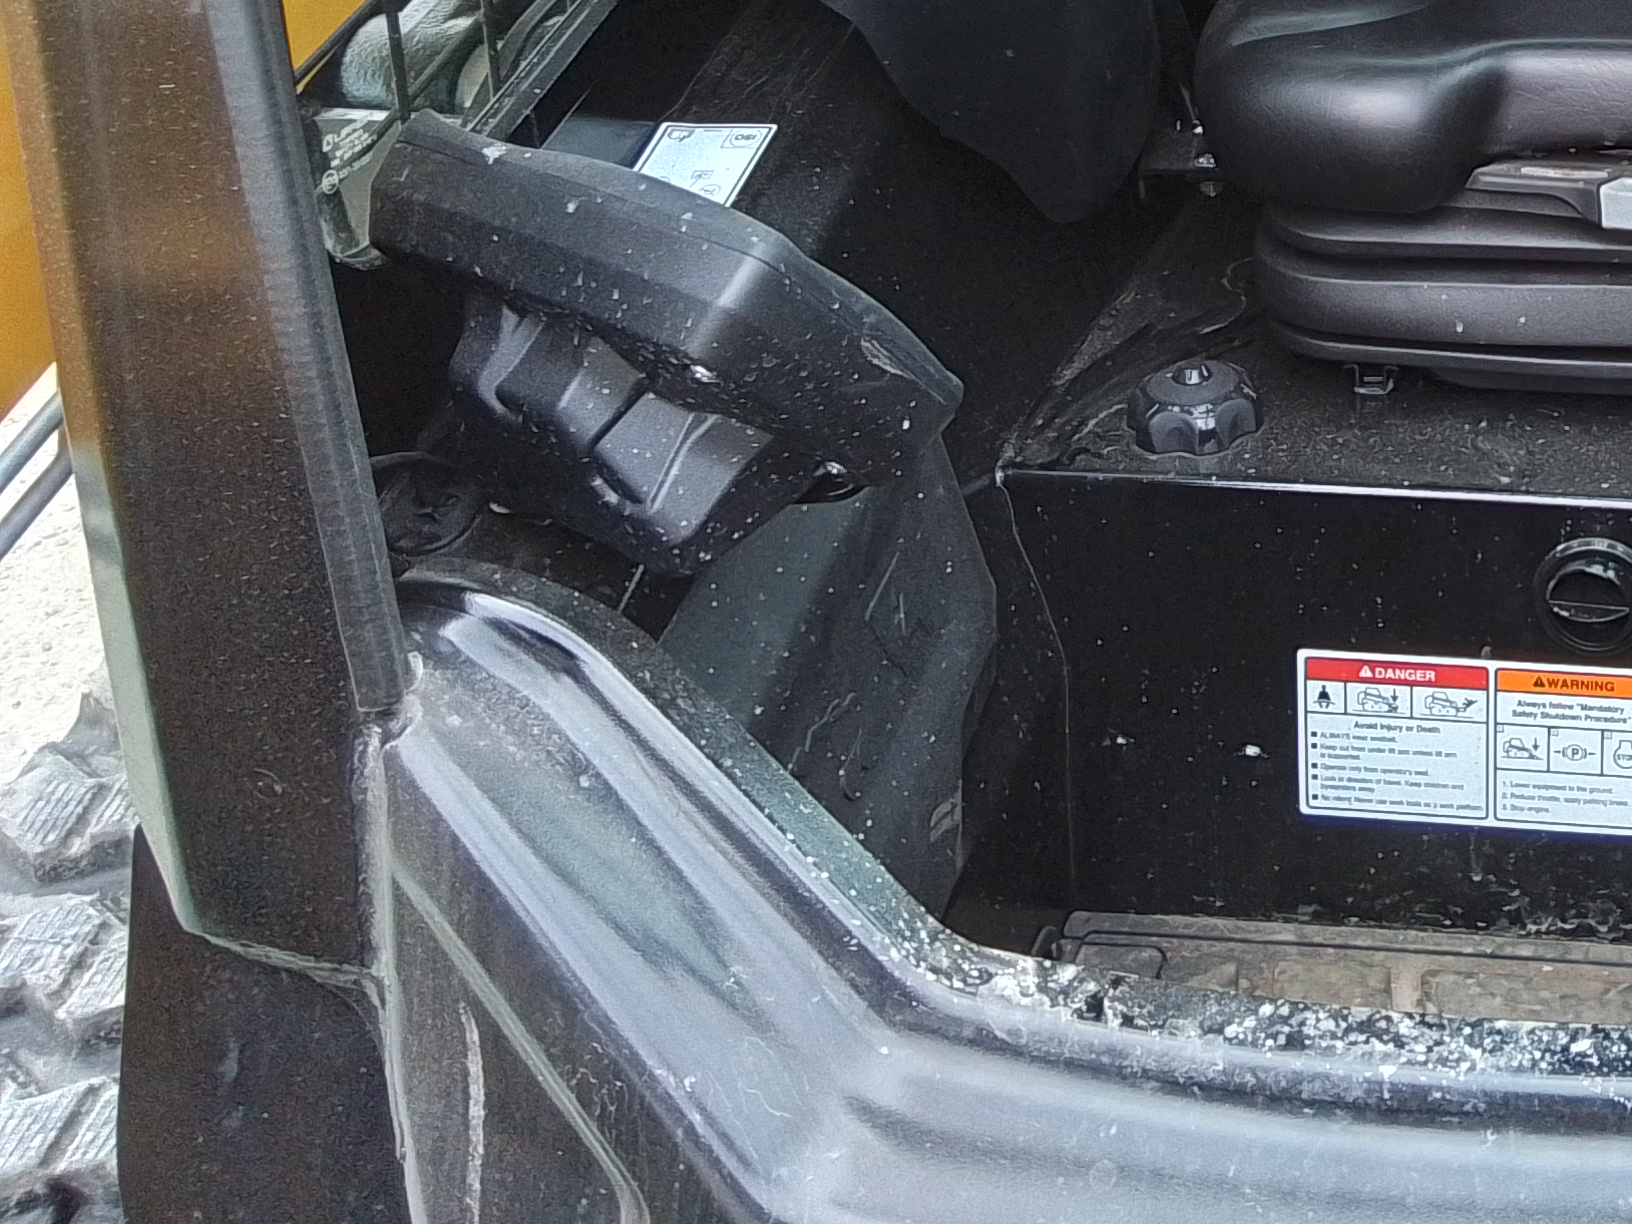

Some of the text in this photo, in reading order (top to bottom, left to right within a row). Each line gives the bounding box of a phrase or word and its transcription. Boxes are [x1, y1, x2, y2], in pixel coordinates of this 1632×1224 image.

[1375, 667, 1436, 682] DANGER
[1547, 677, 1615, 692] WARNING
[1517, 700, 1547, 710] Always
[1512, 710, 1538, 720] Safety
[1354, 721, 1377, 730] Avoid
[1380, 723, 1403, 733] Injury
[1405, 724, 1414, 733] or
[1571, 748, 1580, 758] P
